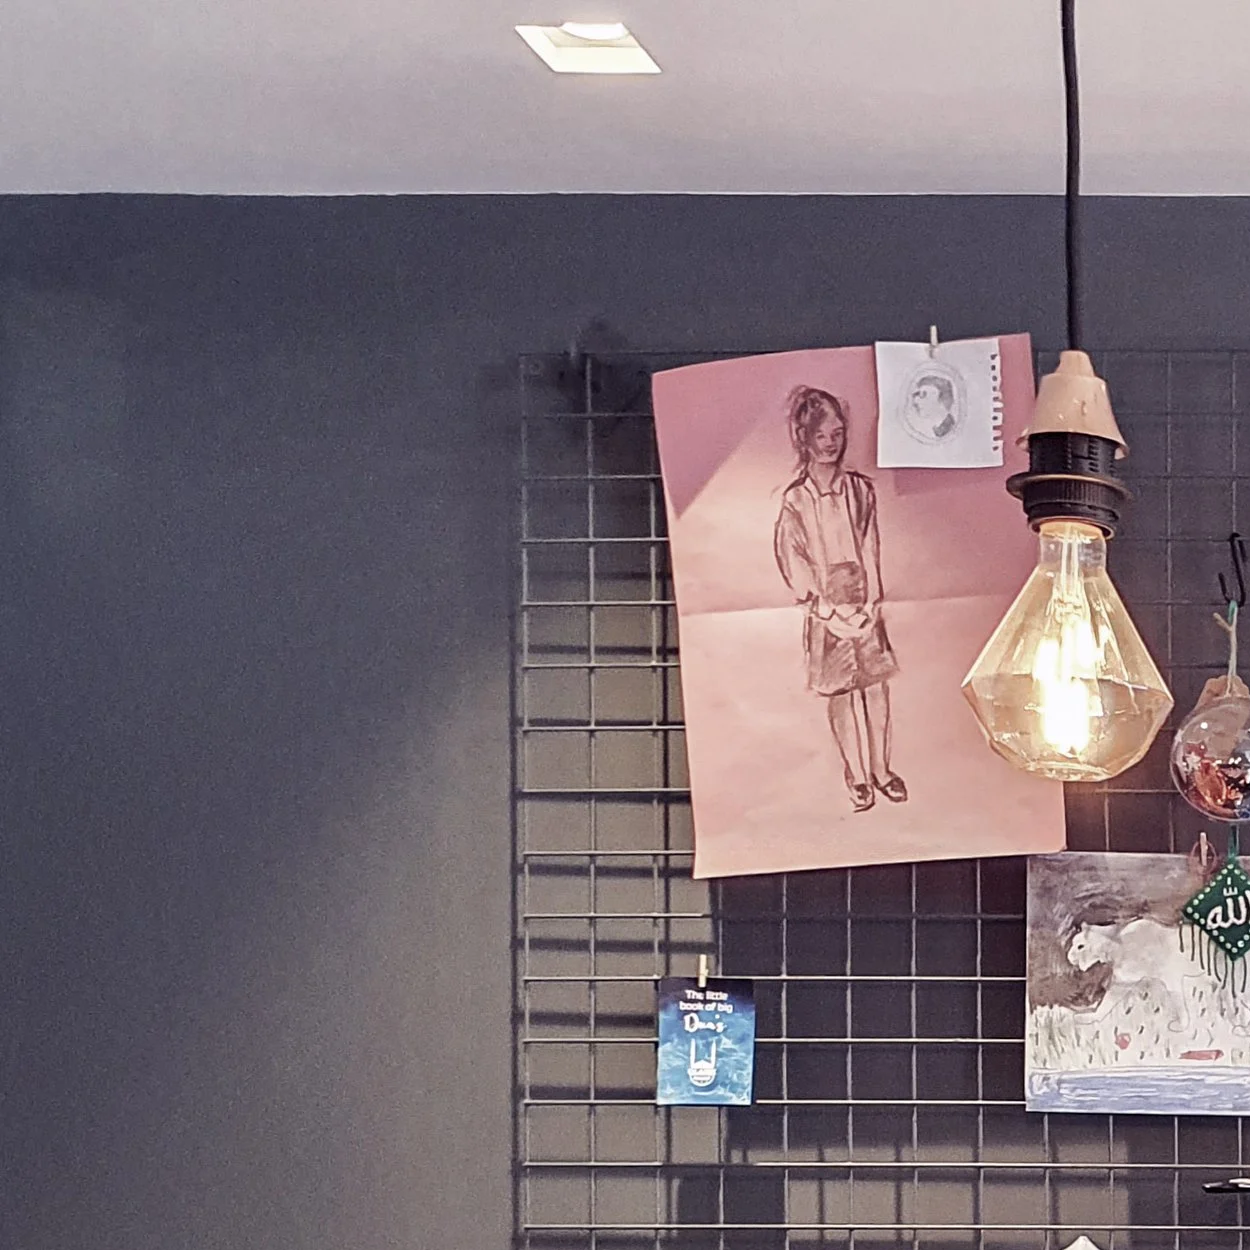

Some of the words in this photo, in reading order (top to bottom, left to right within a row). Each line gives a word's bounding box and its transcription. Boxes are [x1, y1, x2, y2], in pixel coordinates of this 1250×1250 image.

[684, 989, 704, 1000] The
[706, 990, 729, 1001] little
[679, 1000, 704, 1011] book
[705, 1002, 717, 1011] of
[717, 1002, 733, 1014] big
